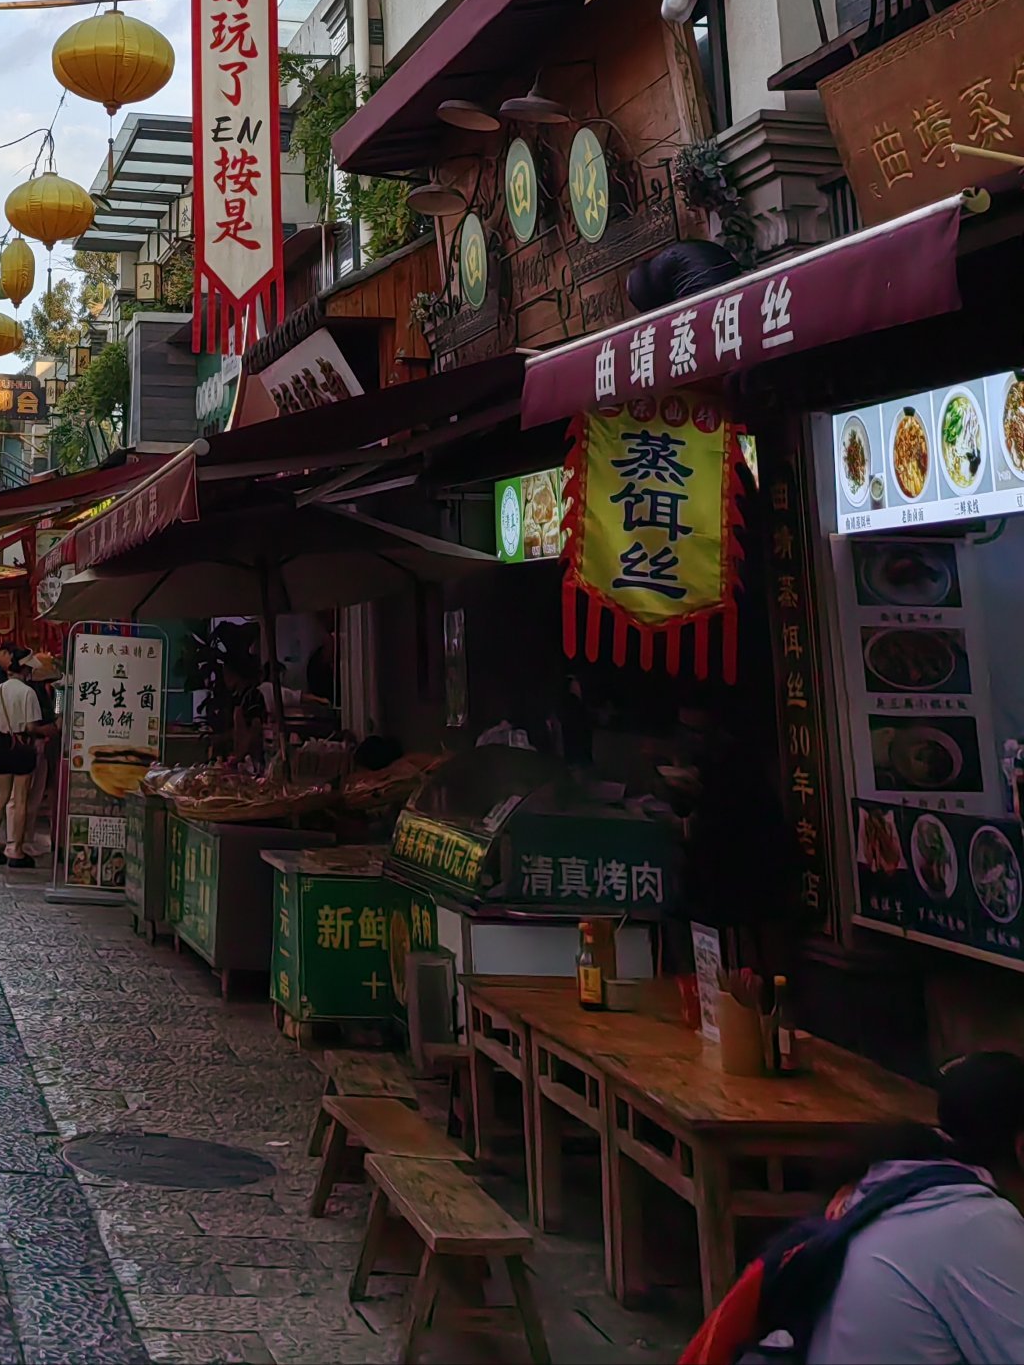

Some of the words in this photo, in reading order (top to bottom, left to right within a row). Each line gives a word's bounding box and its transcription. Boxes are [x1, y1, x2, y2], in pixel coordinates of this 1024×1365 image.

[140, 272, 152, 291] 马
[594, 276, 795, 402] 曲靖蒸饵丝
[610, 429, 695, 600] 蒸饵丝
[79, 641, 158, 659] 云南民族特色
[78, 680, 157, 712] 野生菌
[98, 709, 136, 731] 馅饼
[521, 854, 664, 904] 清真烤肉
